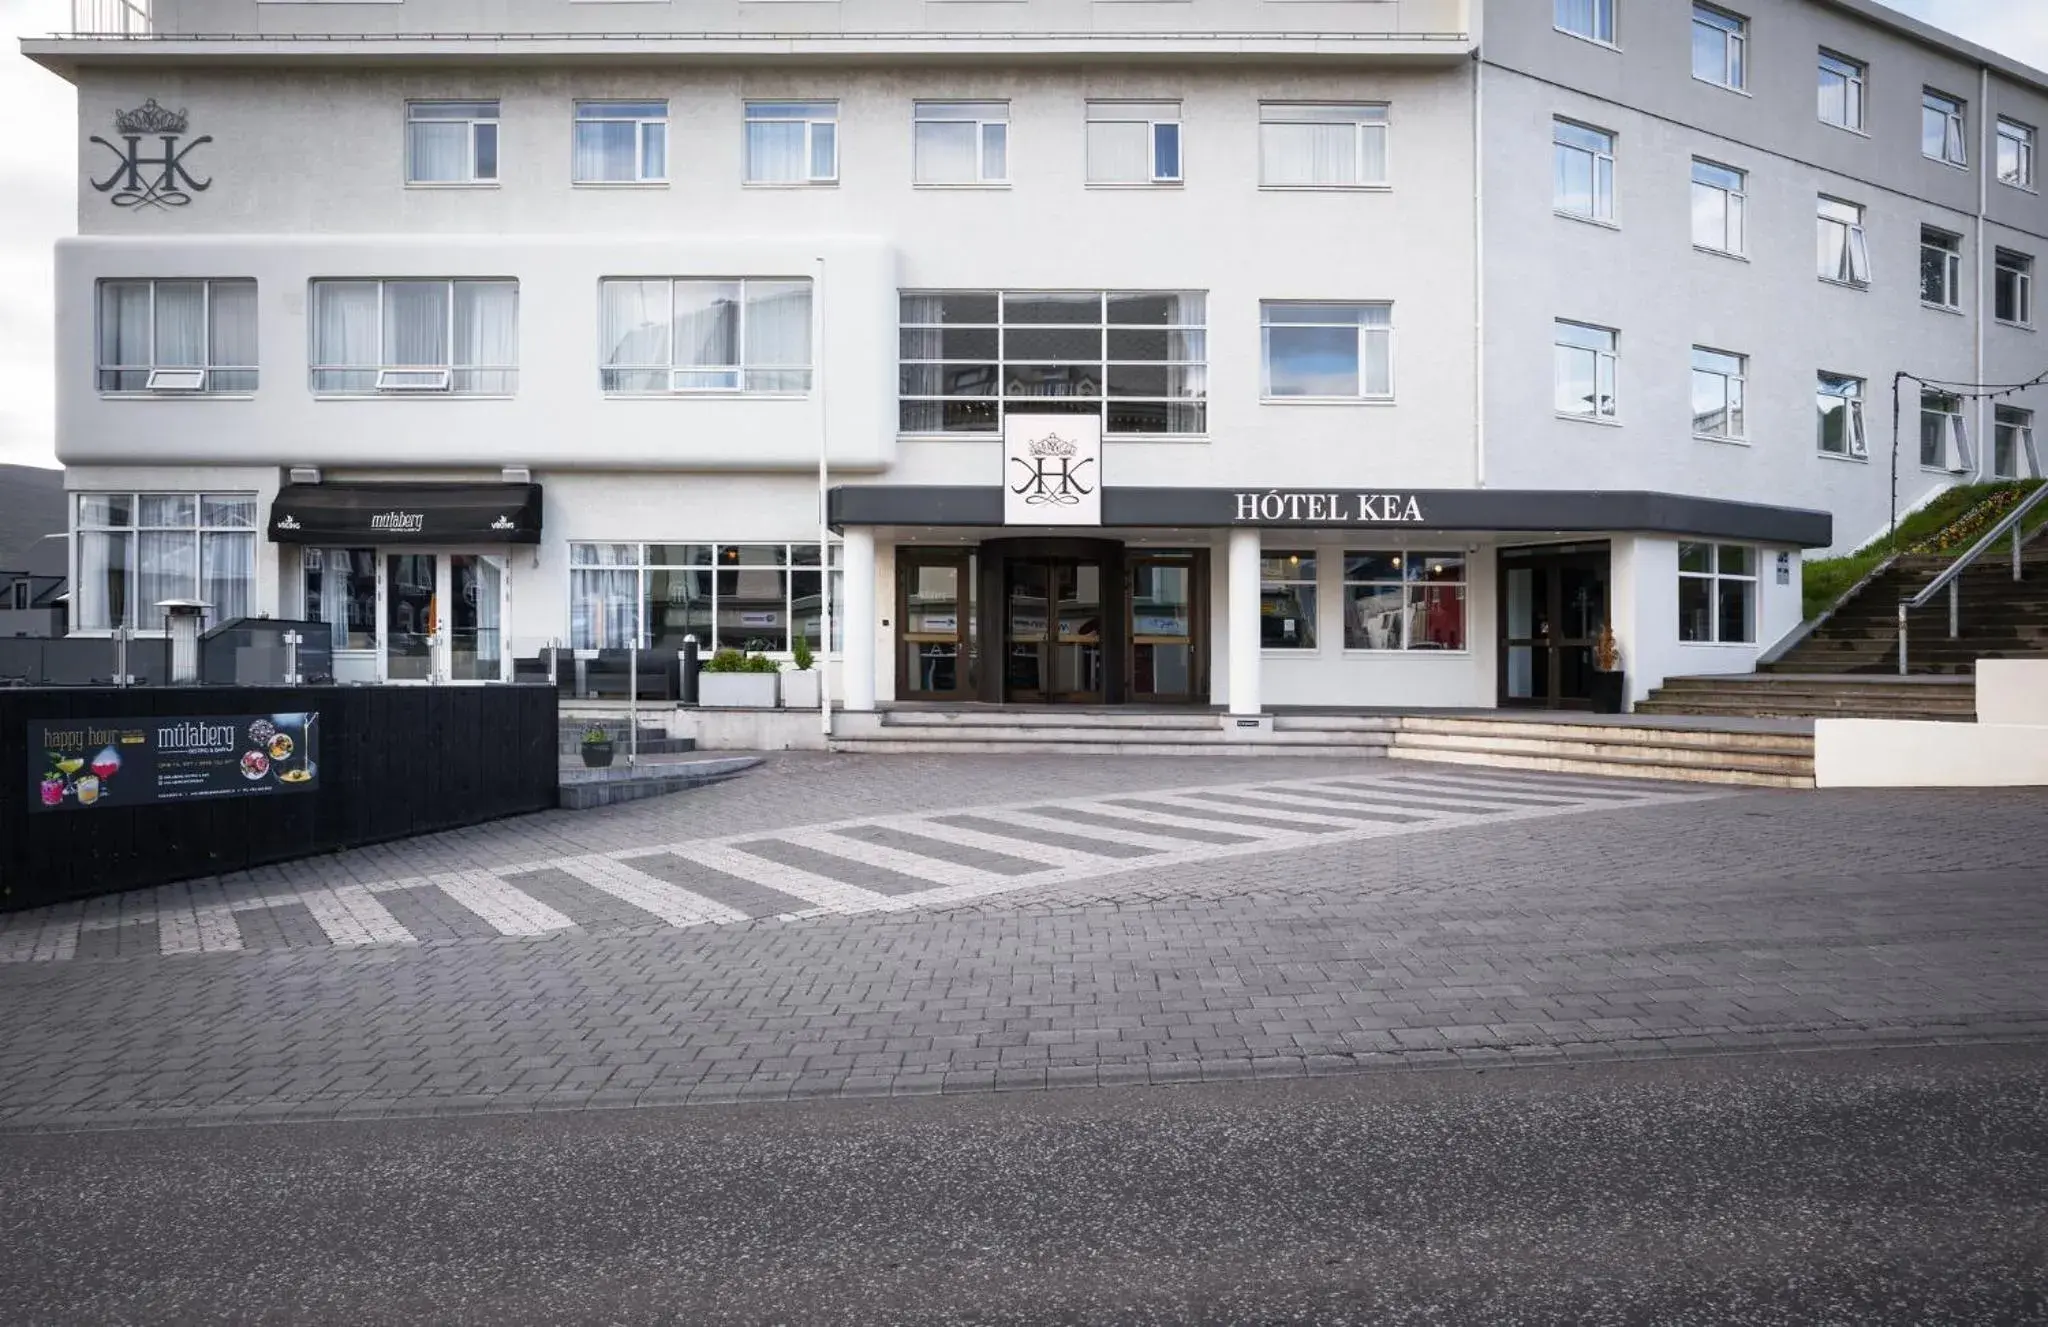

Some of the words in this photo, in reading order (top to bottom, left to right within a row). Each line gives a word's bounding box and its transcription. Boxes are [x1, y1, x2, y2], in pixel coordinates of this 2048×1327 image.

[1234, 489, 1349, 521] HÓTEL
[1356, 494, 1425, 522] KEA
[44, 727, 84, 752] happy
[88, 726, 118, 746] hour
[157, 721, 236, 752] múlaberg
